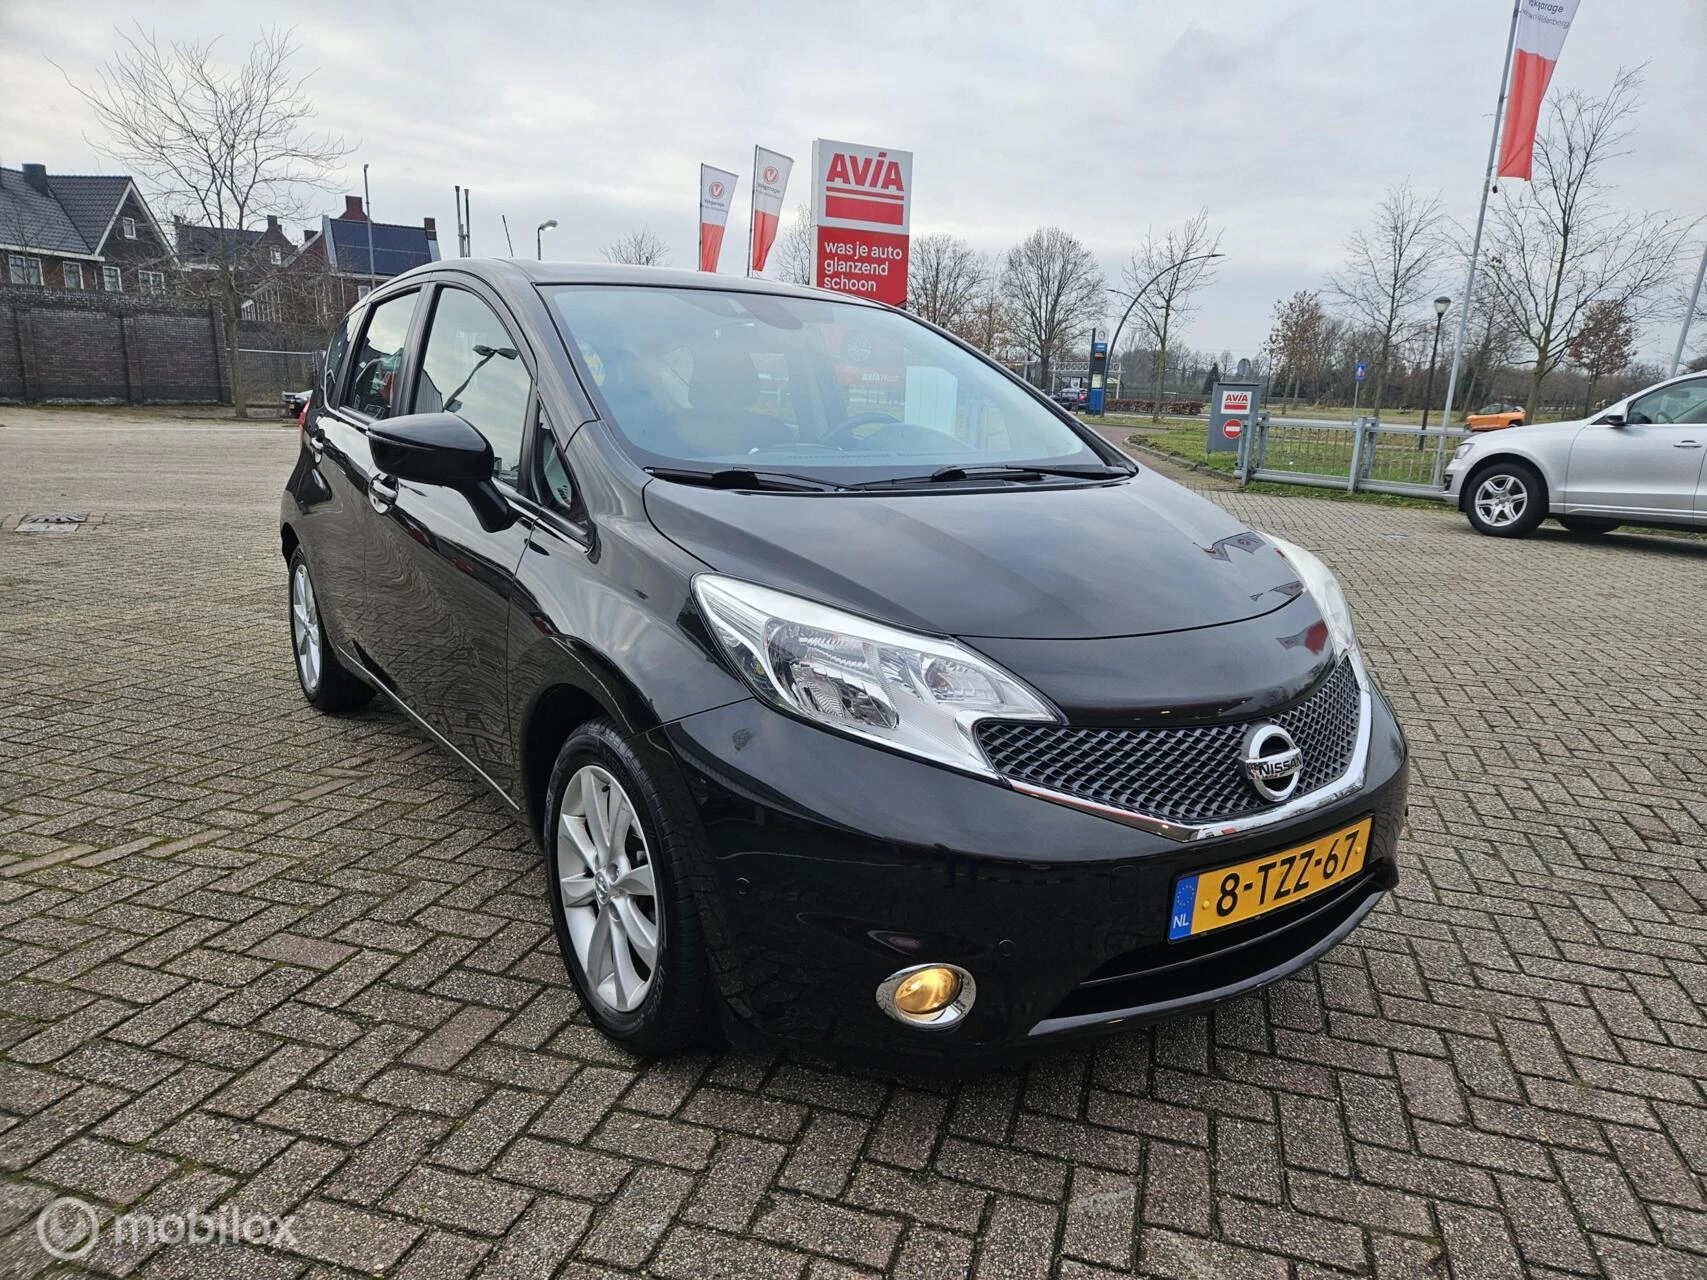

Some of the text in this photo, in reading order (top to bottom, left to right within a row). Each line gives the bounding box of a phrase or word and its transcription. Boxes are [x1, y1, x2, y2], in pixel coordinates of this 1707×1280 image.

[825, 241, 902, 260] was je auto
[824, 257, 889, 276] glanzend
[823, 275, 876, 292] schoon
[1259, 752, 1302, 776] NISSAN
[1216, 830, 1360, 917] 8-TZZ-67
[1173, 913, 1190, 929] NL
